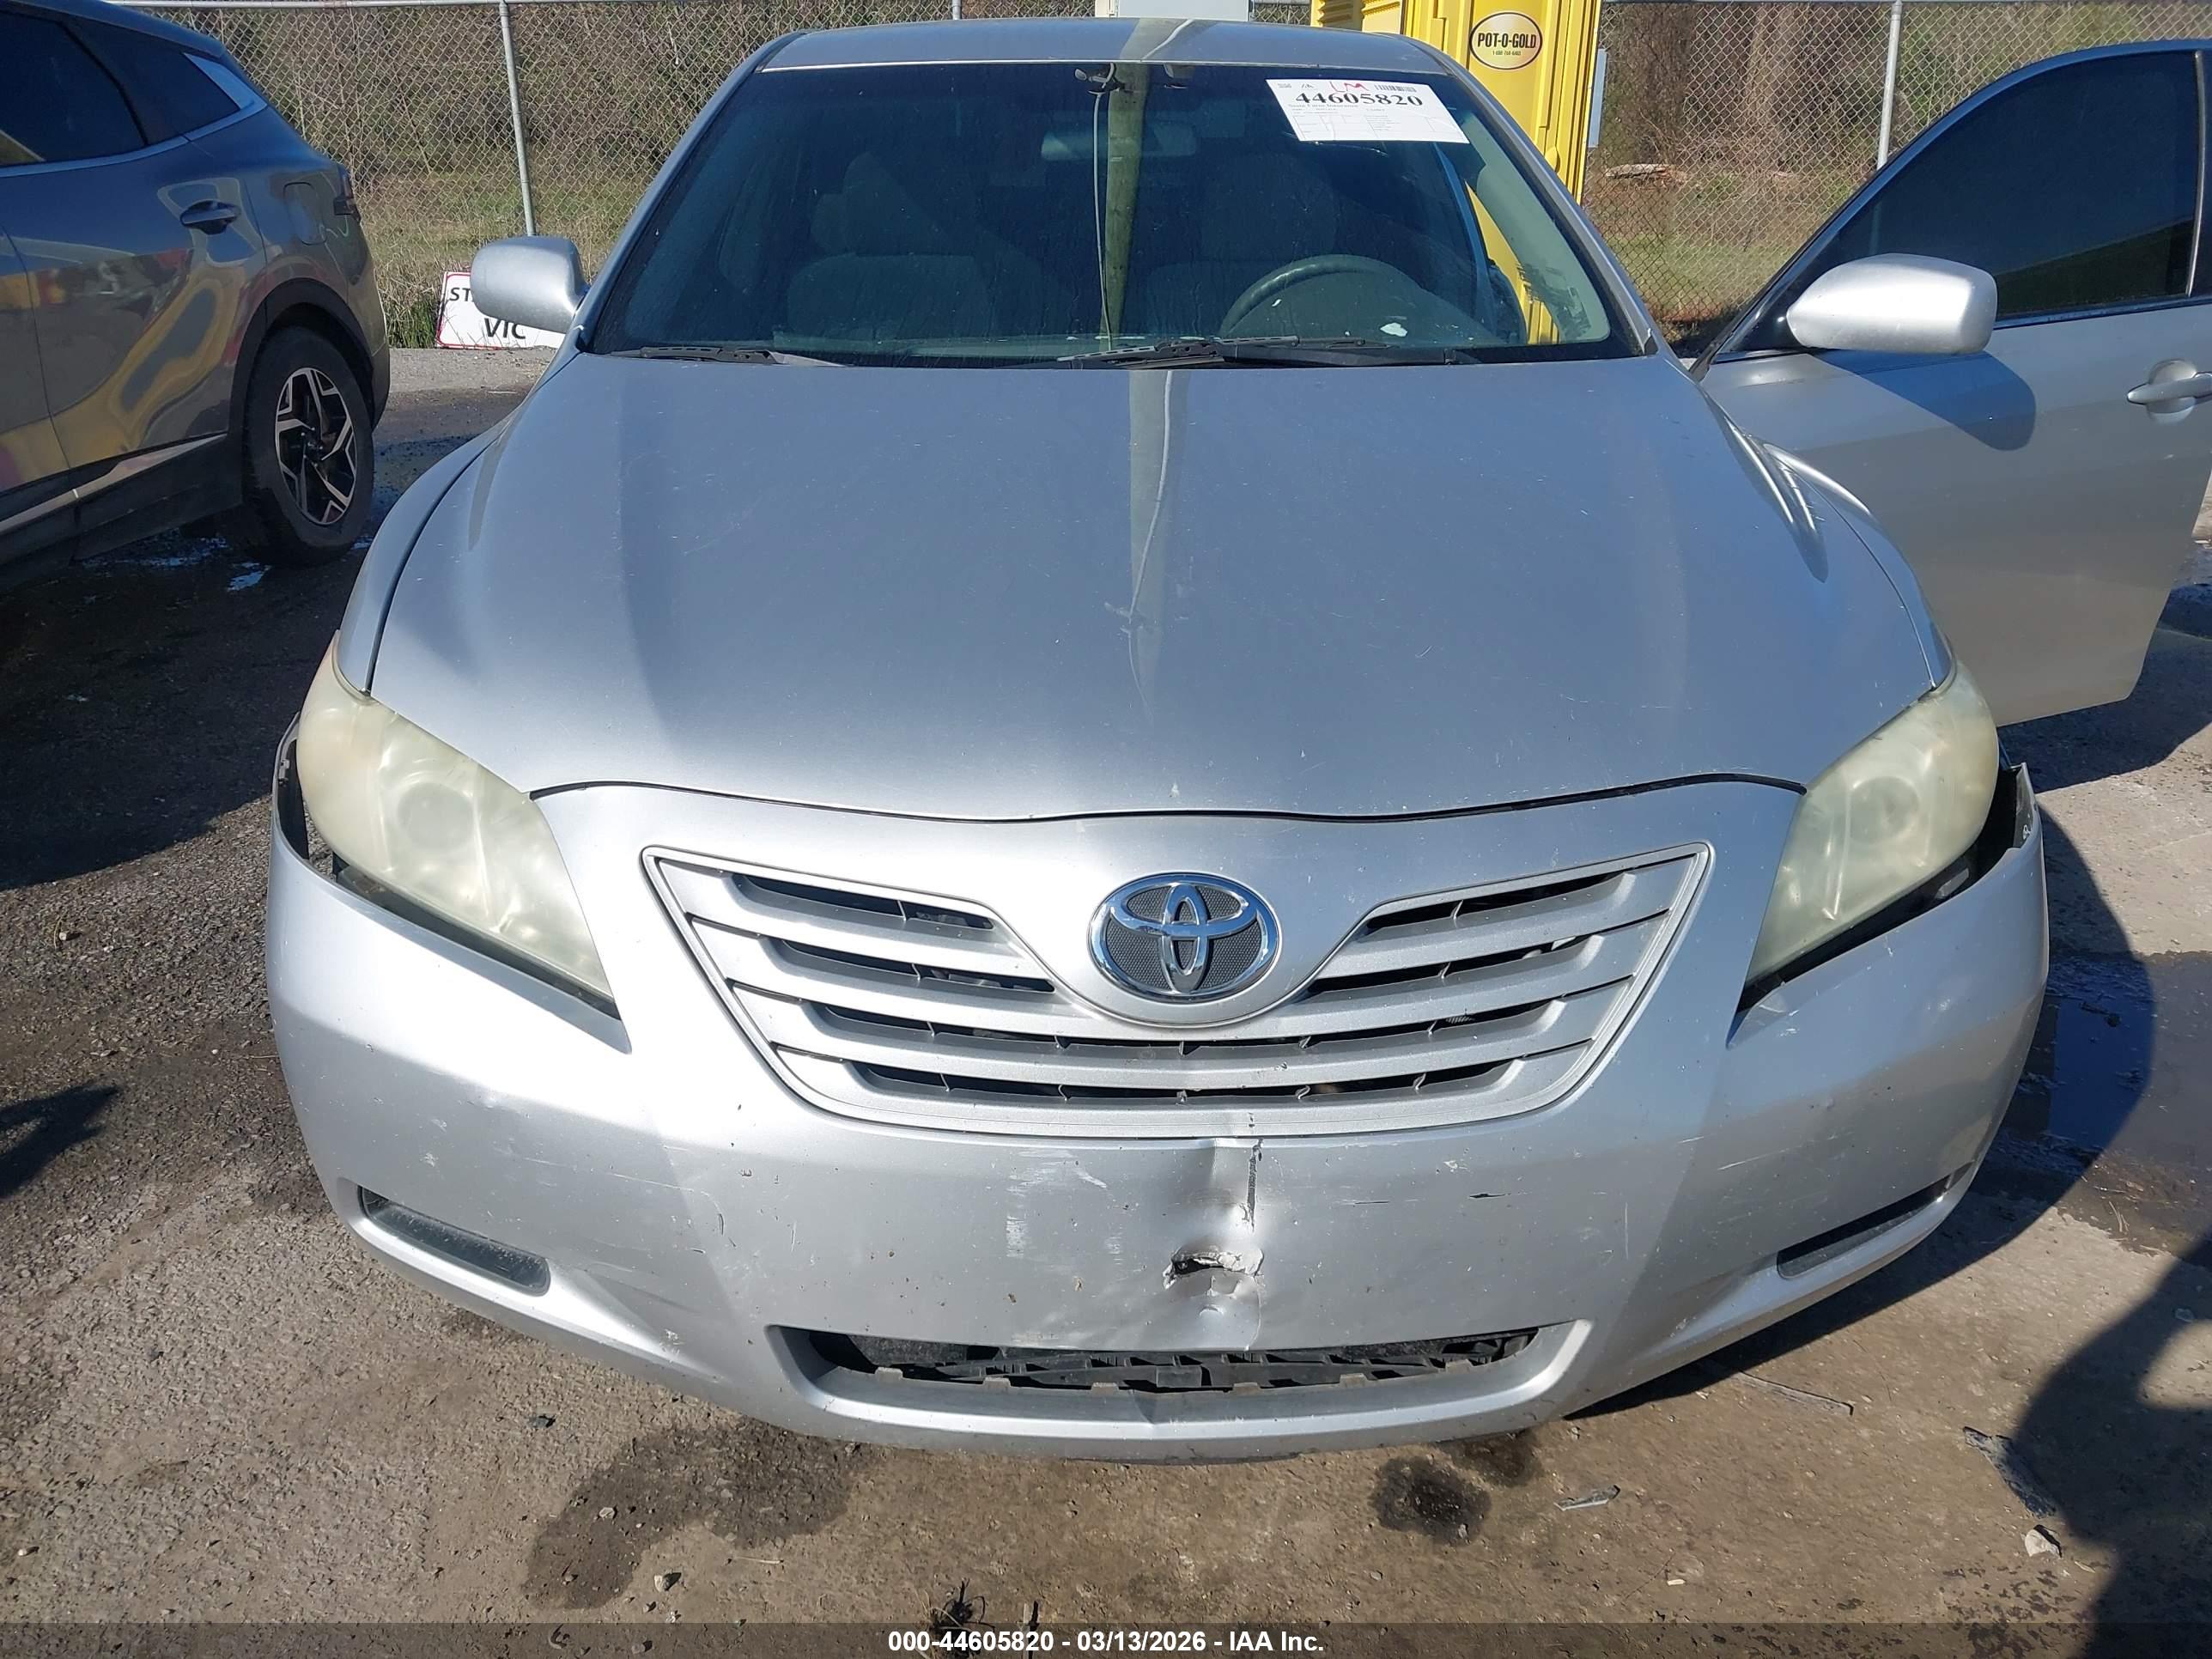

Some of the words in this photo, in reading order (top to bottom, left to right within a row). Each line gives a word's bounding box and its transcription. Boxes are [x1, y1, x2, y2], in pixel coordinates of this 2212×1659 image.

[1477, 32, 1537, 49] POT-O-GOLD
[1295, 92, 1424, 106] 44605820
[483, 318, 526, 339] VIC
